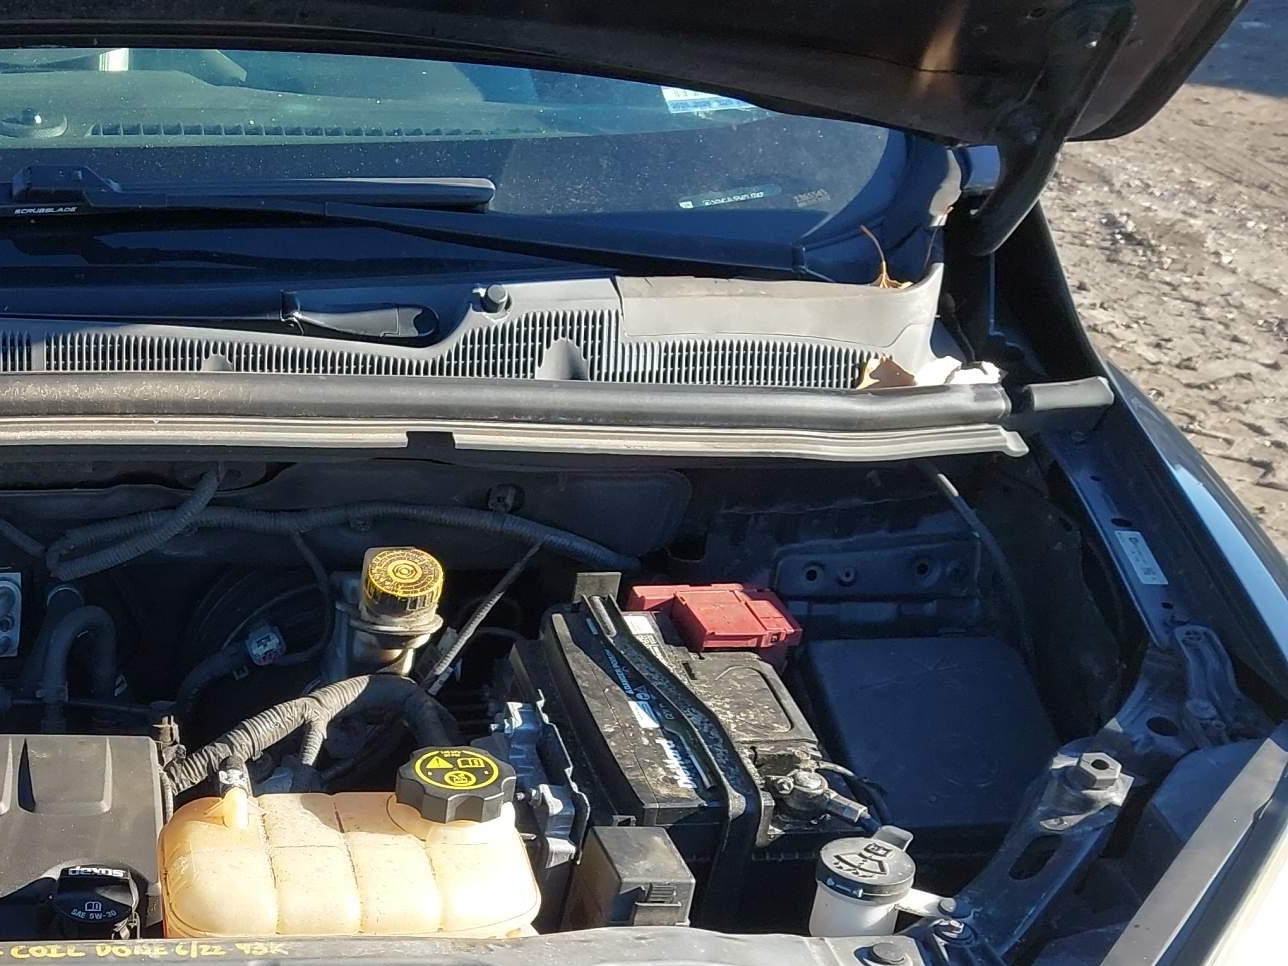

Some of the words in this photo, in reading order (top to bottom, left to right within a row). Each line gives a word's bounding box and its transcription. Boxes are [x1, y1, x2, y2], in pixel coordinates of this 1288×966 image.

[68, 866, 128, 878] dexos
[70, 908, 87, 920] SAE
[89, 909, 118, 921] 5W-30
[175, 940, 227, 959] 6/22
